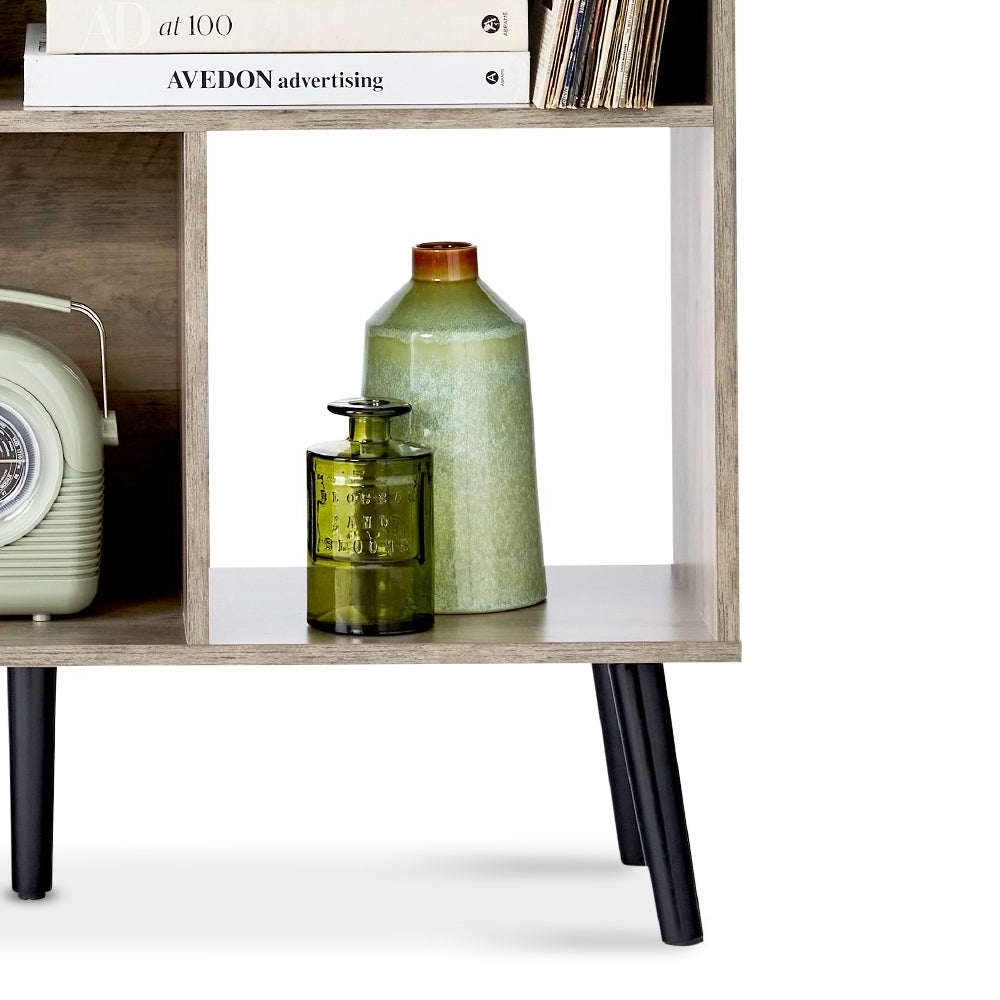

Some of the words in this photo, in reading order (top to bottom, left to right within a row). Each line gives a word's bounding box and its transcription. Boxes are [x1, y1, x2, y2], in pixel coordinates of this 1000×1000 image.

[81, 1, 150, 50] AD
[158, 16, 182, 36] at
[187, 14, 233, 37] 100
[167, 69, 274, 89] AVEDON
[277, 71, 384, 92] advertising
